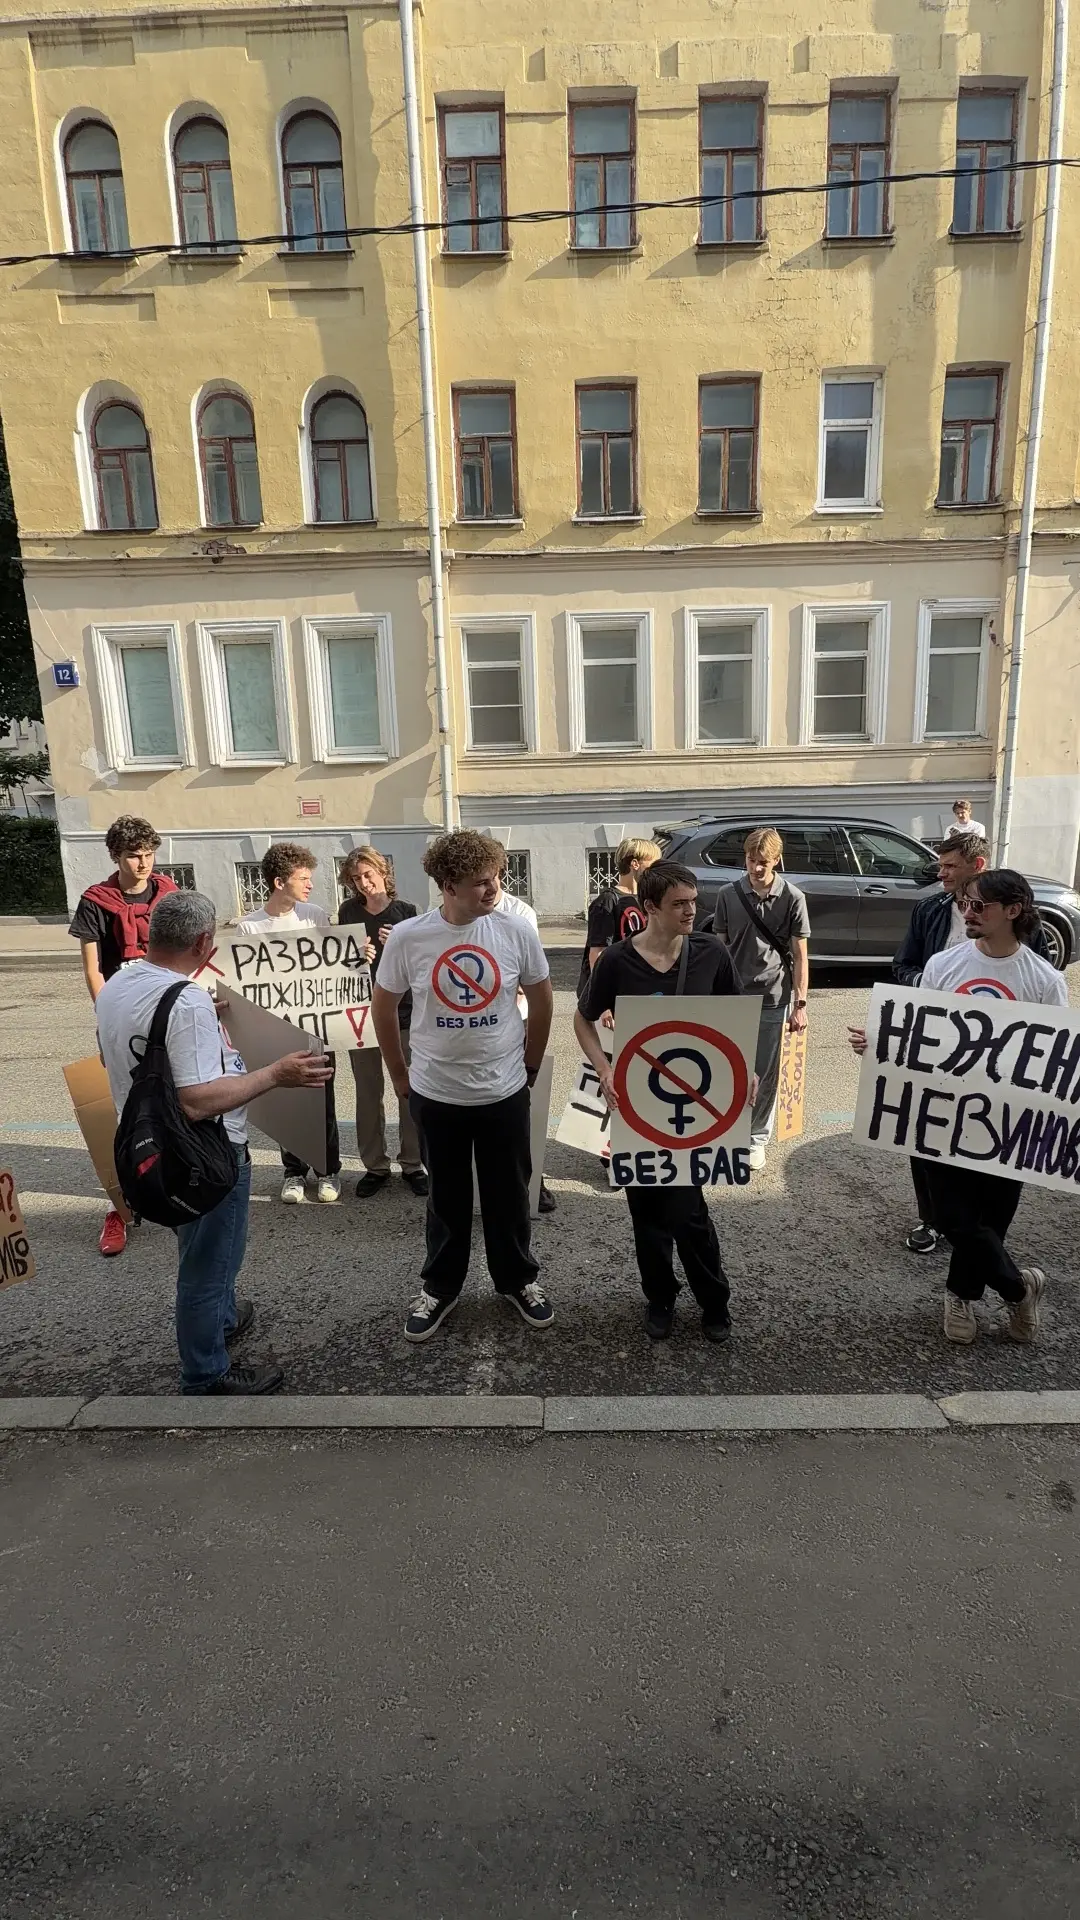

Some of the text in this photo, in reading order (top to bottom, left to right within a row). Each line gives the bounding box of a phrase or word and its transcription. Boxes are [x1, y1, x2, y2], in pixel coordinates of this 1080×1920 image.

[57, 669, 71, 680] 12
[231, 934, 368, 981] РАЗВОД
[242, 972, 372, 1009] ПОЖИЗНЕННЫЙ
[436, 1014, 498, 1029] БЕЗ БАБ
[868, 1075, 1080, 1184] НЕВИНОВ
[612, 1146, 751, 1185] БЕЗ БАБ
